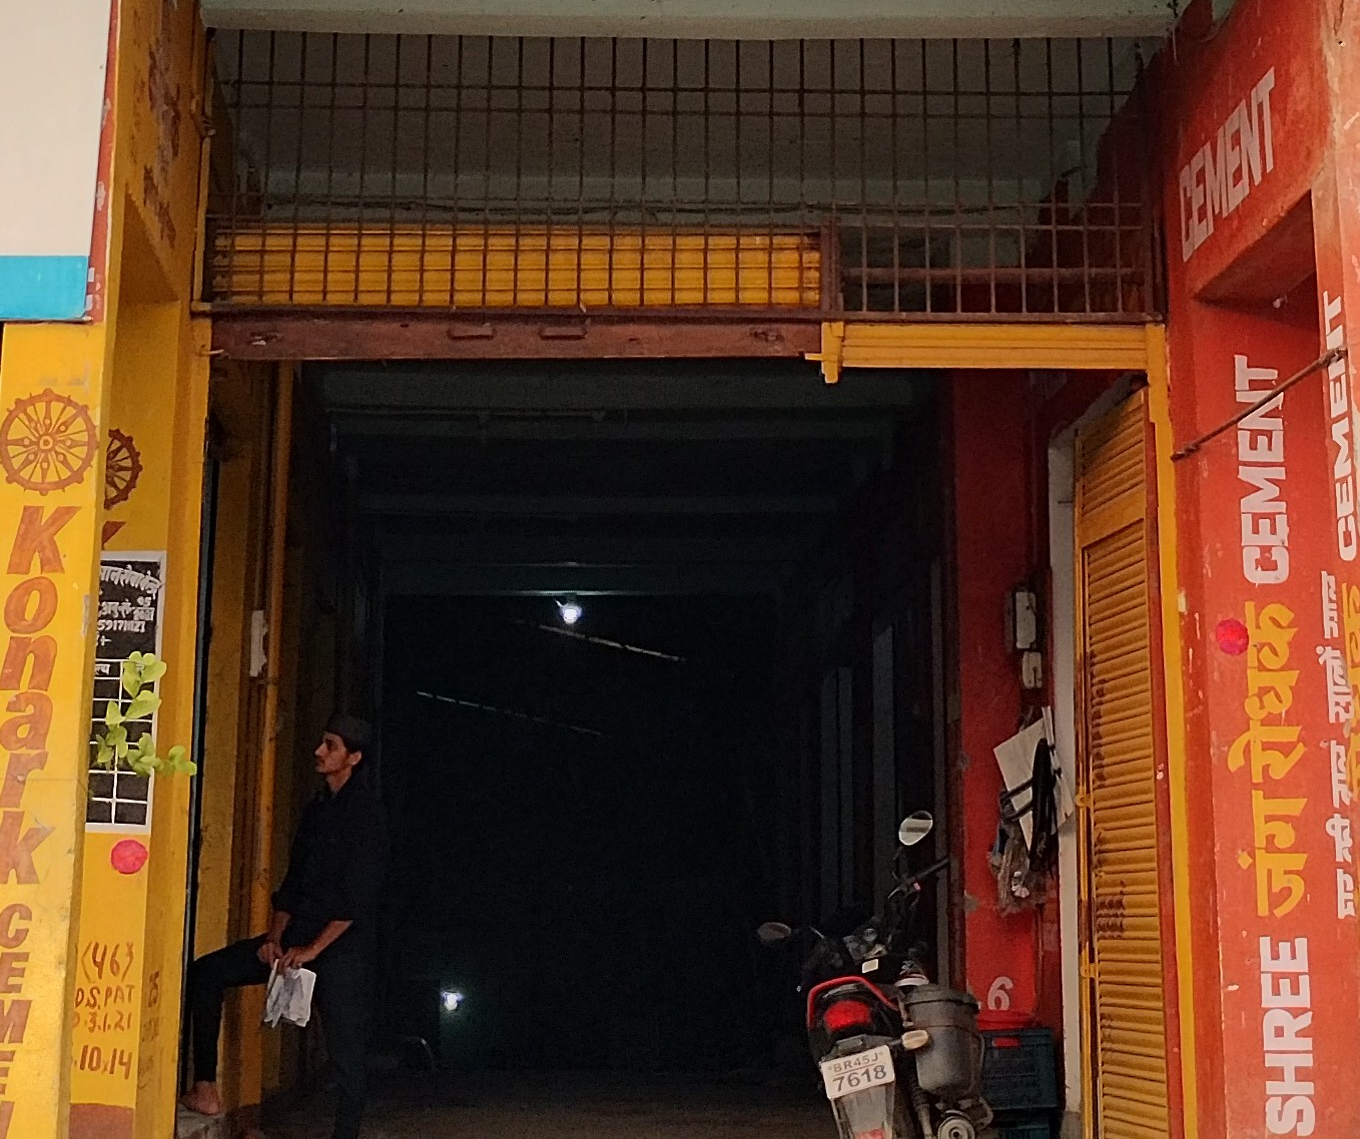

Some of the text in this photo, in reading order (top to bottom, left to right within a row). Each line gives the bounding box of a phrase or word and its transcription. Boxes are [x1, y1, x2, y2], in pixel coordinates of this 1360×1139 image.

[1178, 67, 1276, 264] CEMENT
[1321, 289, 1359, 562] CEMENT
[1226, 353, 1317, 1139] SHREE जंग रोधक CEMENT
[831, 1064, 888, 1093] 7618
